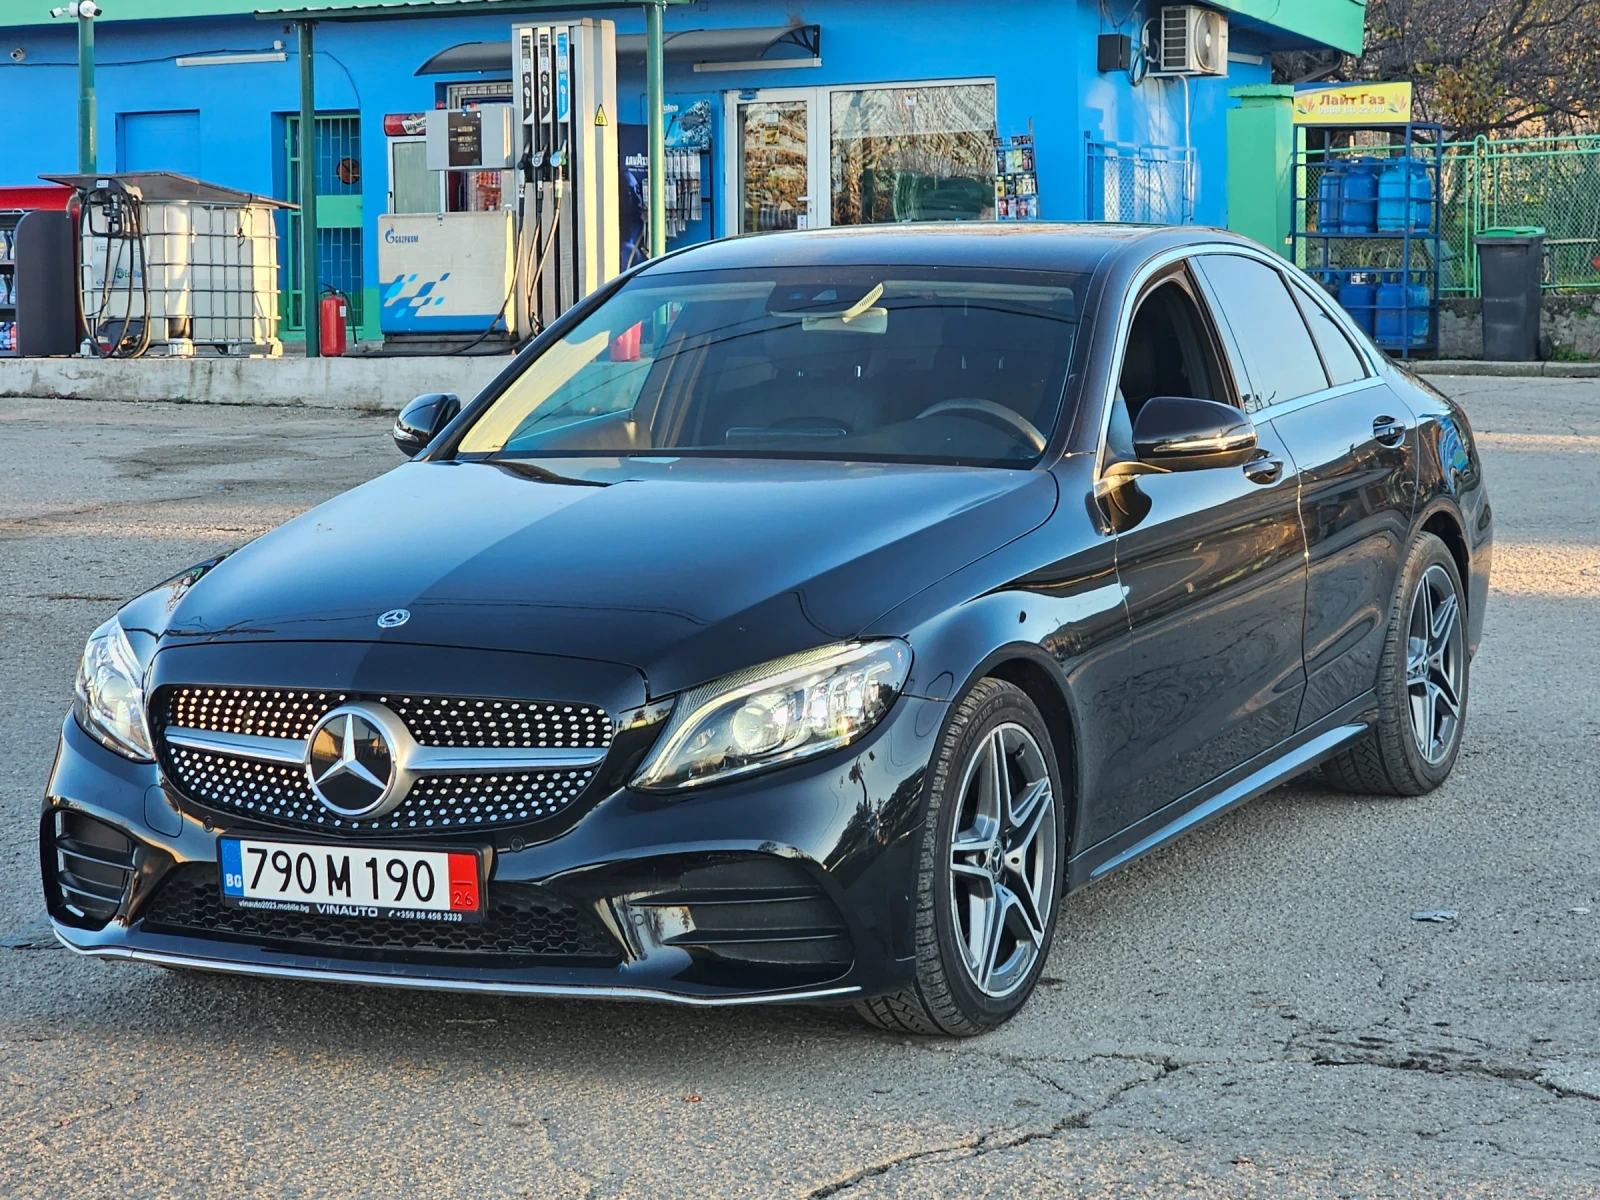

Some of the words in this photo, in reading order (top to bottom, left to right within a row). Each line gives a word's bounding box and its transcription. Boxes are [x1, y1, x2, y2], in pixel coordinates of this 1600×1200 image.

[1319, 94, 1357, 106] Лайт
[1360, 94, 1386, 105] Газ
[662, 104, 679, 113] aleo
[625, 153, 648, 166] LAVAZ
[225, 873, 242, 888] BG
[247, 847, 317, 895] 790
[326, 854, 351, 898] M
[365, 857, 435, 903] 190
[453, 890, 474, 907] 26
[316, 904, 379, 918] VINAUTO
